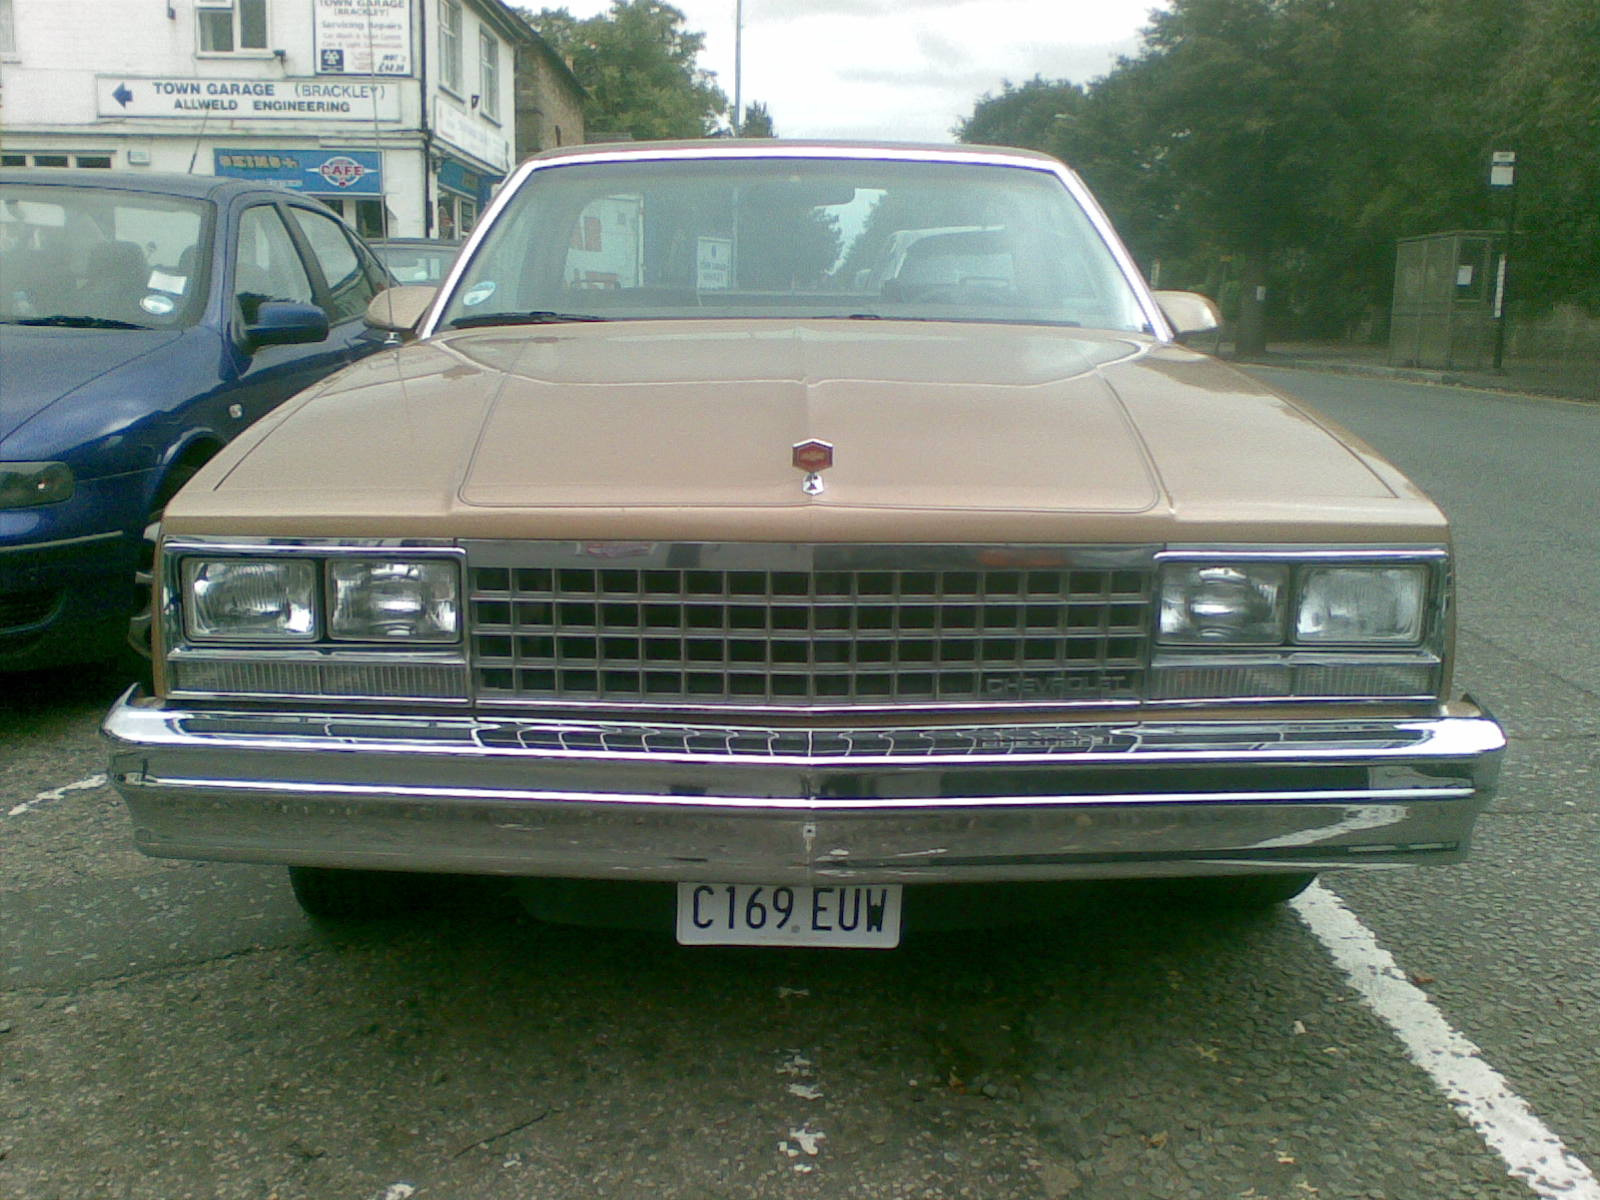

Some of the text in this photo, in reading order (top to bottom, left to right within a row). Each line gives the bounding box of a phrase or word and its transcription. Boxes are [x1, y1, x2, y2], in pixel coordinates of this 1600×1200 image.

[152, 82, 386, 99] TOWN GARAGE (BRACKLEY)
[174, 98, 350, 113] ALLWELD ENGINEERING
[321, 165, 363, 177] CAFE
[692, 885, 888, 932] C169 EUW
